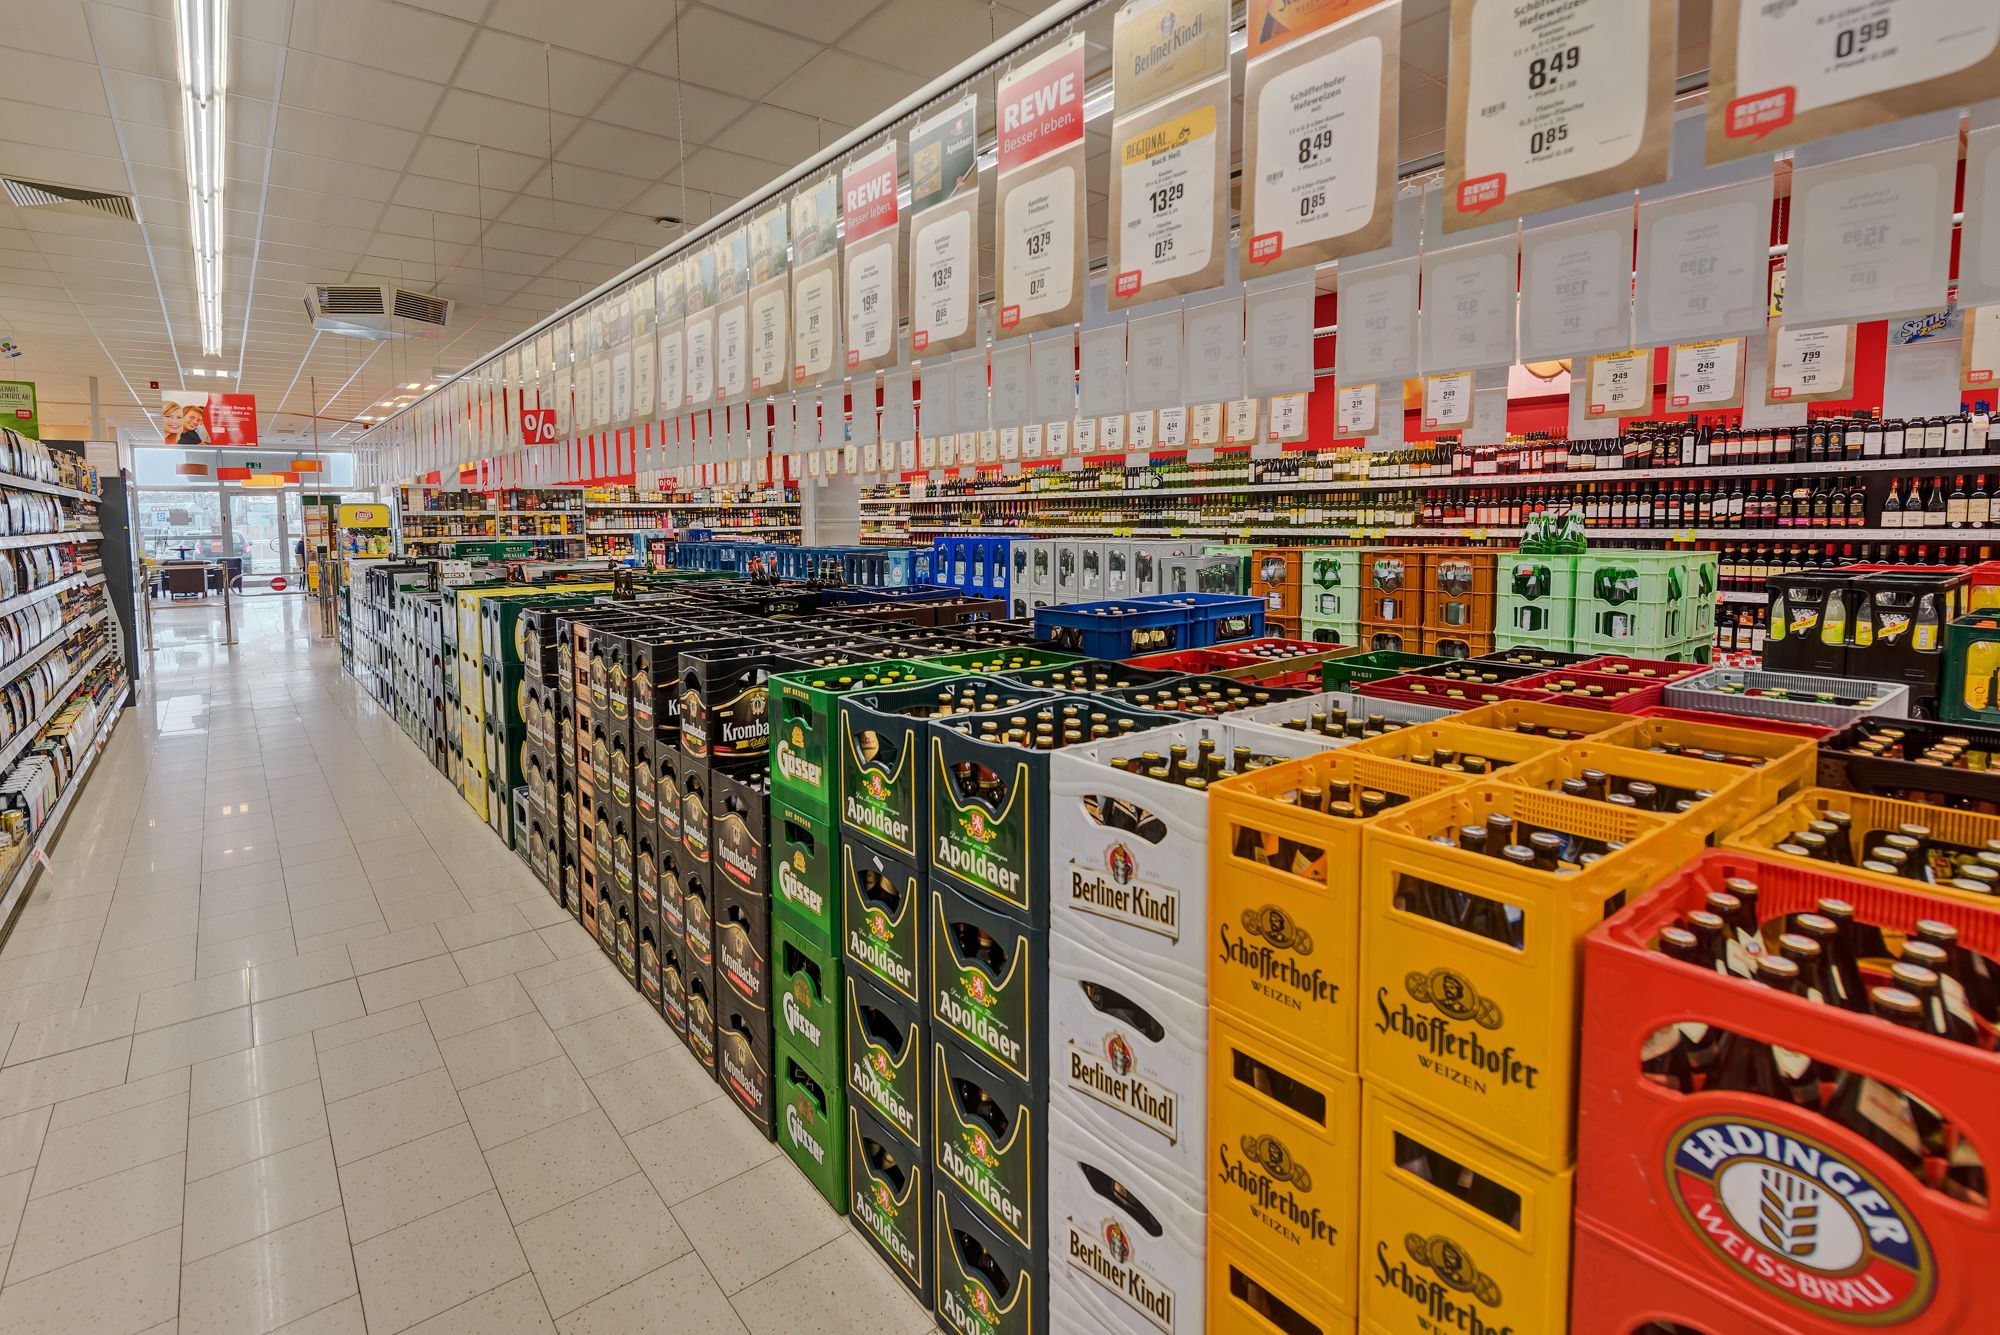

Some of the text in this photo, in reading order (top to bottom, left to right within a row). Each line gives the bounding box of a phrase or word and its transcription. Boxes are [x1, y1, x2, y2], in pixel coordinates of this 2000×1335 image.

[1134, 13, 1202, 76] Berliner Kindl
[1835, 18, 1889, 58] 0.99
[1290, 75, 1347, 103] Schöfferhofer
[1529, 46, 1580, 90] 8.49
[1004, 73, 1075, 133] REWE
[1293, 87, 1342, 112] Hefeweizen
[1734, 93, 1787, 117] REWE
[1004, 112, 1075, 153] Besser leben.
[1126, 129, 1167, 160] REGIONAL
[1299, 130, 1332, 163] 8.49
[1530, 123, 1568, 154] 0.85
[1152, 149, 1182, 167] Bock Hell
[847, 171, 892, 213] REWE
[1150, 183, 1184, 213] 13.29
[1300, 193, 1326, 216] 0.85
[1463, 179, 1500, 197] REWE
[848, 202, 892, 229] Besser leben.
[1026, 231, 1051, 256] 13.79
[1154, 238, 1173, 258] 0.75
[932, 266, 952, 288] 13.29
[1030, 278, 1045, 295] 0.70
[1901, 307, 1950, 337] Sprite
[1919, 319, 1946, 336] ZERO
[1612, 372, 1628, 383] 2.49
[1697, 361, 1715, 373] 2.49
[1801, 350, 1821, 363] 7.99
[722, 718, 769, 742] Kromba
[777, 740, 822, 788] Gösser
[847, 795, 909, 844] Apoldaer
[719, 838, 757, 880] Krombacher
[939, 836, 1020, 895] Apoldaer
[779, 860, 823, 916] Gösser
[1072, 871, 1175, 927] Berliner Kindl
[722, 944, 760, 993] Krombacher
[850, 930, 912, 989] Apoldaer
[1219, 922, 1340, 1004] Schöfferhofer
[1250, 980, 1303, 1011] WEIZEN
[783, 991, 821, 1048] Gösser
[940, 990, 1020, 1064] Apoldaer
[1375, 987, 1539, 1090] Schöfferhofer
[724, 1050, 763, 1106] Krombacher
[1071, 1052, 1173, 1128] Berliner Kindl
[1418, 1054, 1487, 1095] WEIZEN
[853, 1062, 914, 1131] Apoldaer
[786, 1103, 824, 1166] Gösser
[942, 1141, 1022, 1230] Apoldaer
[1219, 1144, 1339, 1247] Schöfferhofer
[1681, 1124, 1910, 1246] ERDINGER
[856, 1191, 915, 1271] Apoldaer
[1249, 1204, 1301, 1247] WEIZEN
[1070, 1229, 1171, 1324] Berliner Kindl
